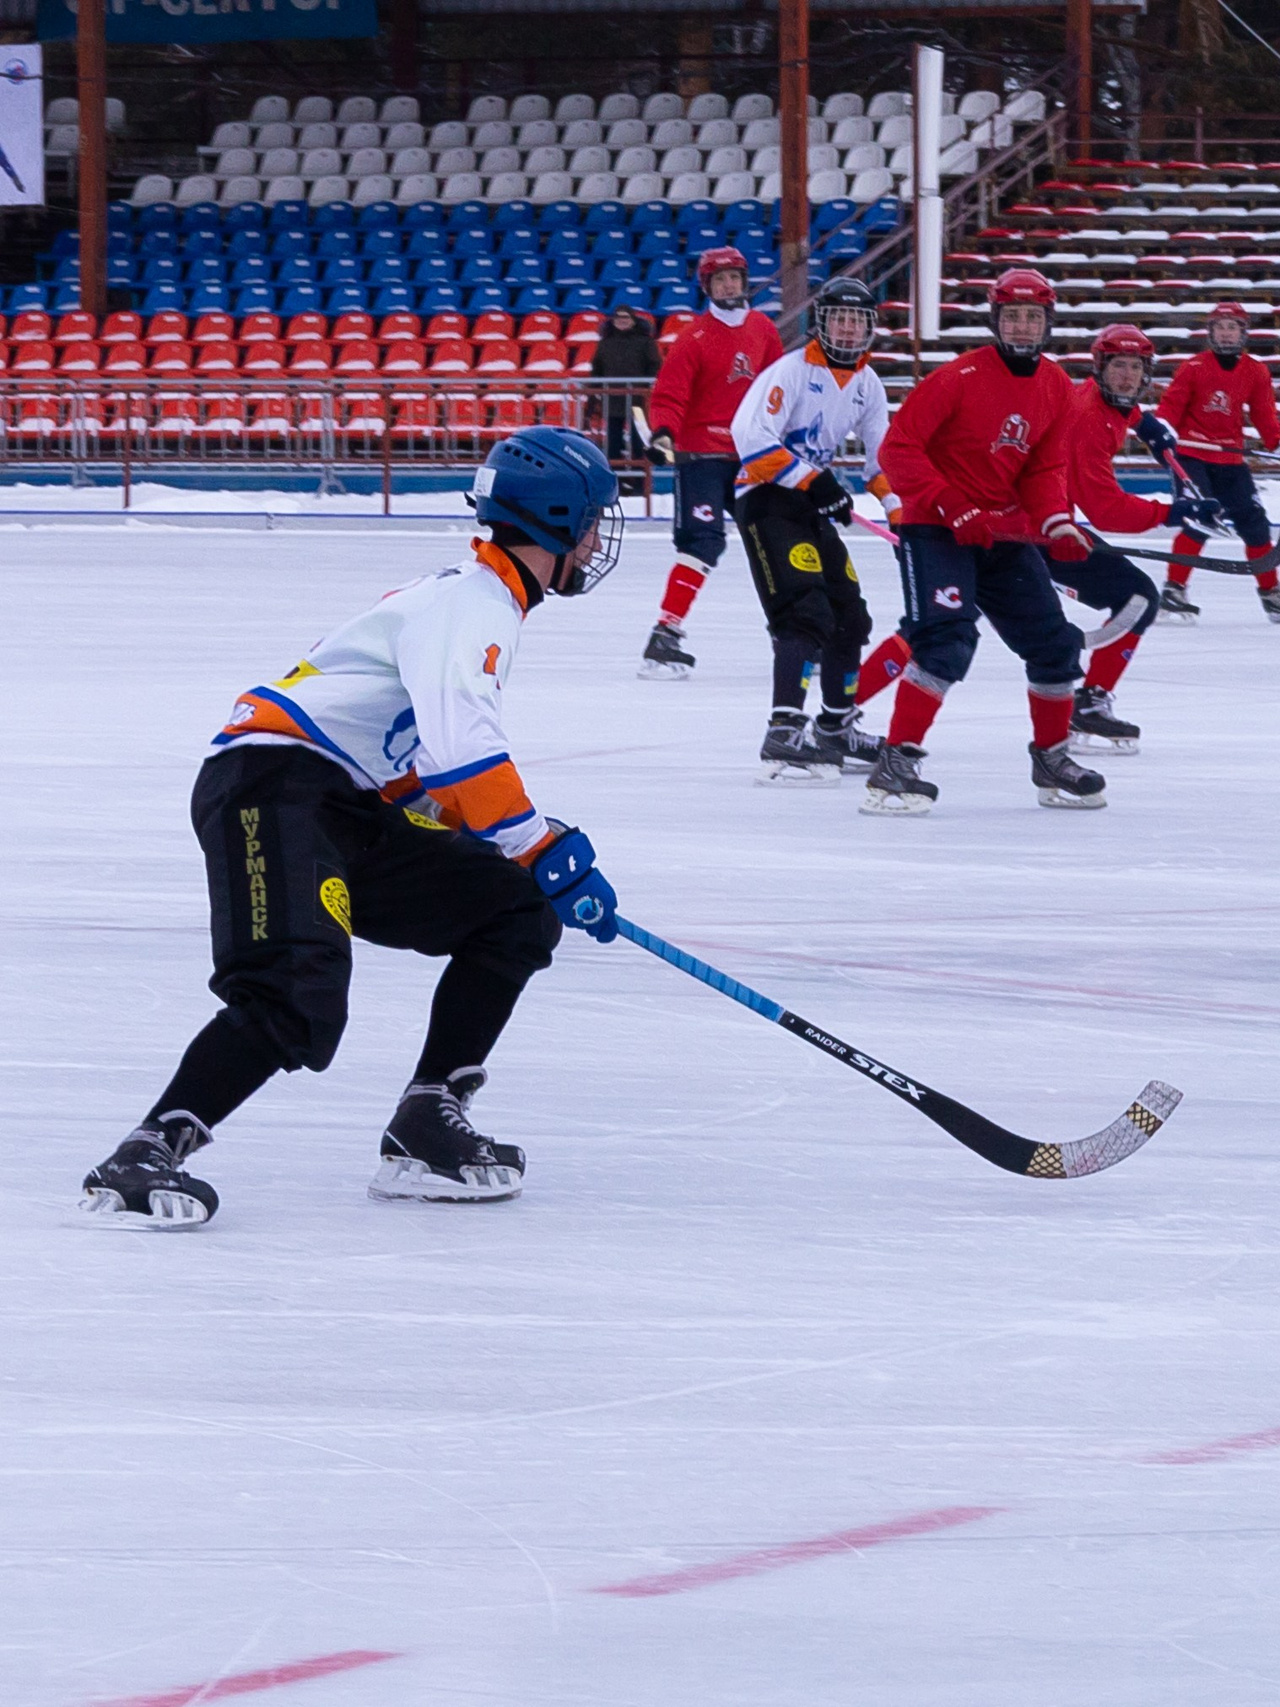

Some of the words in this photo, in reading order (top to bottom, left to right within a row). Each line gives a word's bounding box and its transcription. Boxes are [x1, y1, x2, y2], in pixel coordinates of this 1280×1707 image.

[767, 385, 783, 414] 9
[240, 807, 268, 940] МУРМАНСК
[804, 1027, 847, 1055] RAIDER
[849, 1052, 926, 1100] STEX
